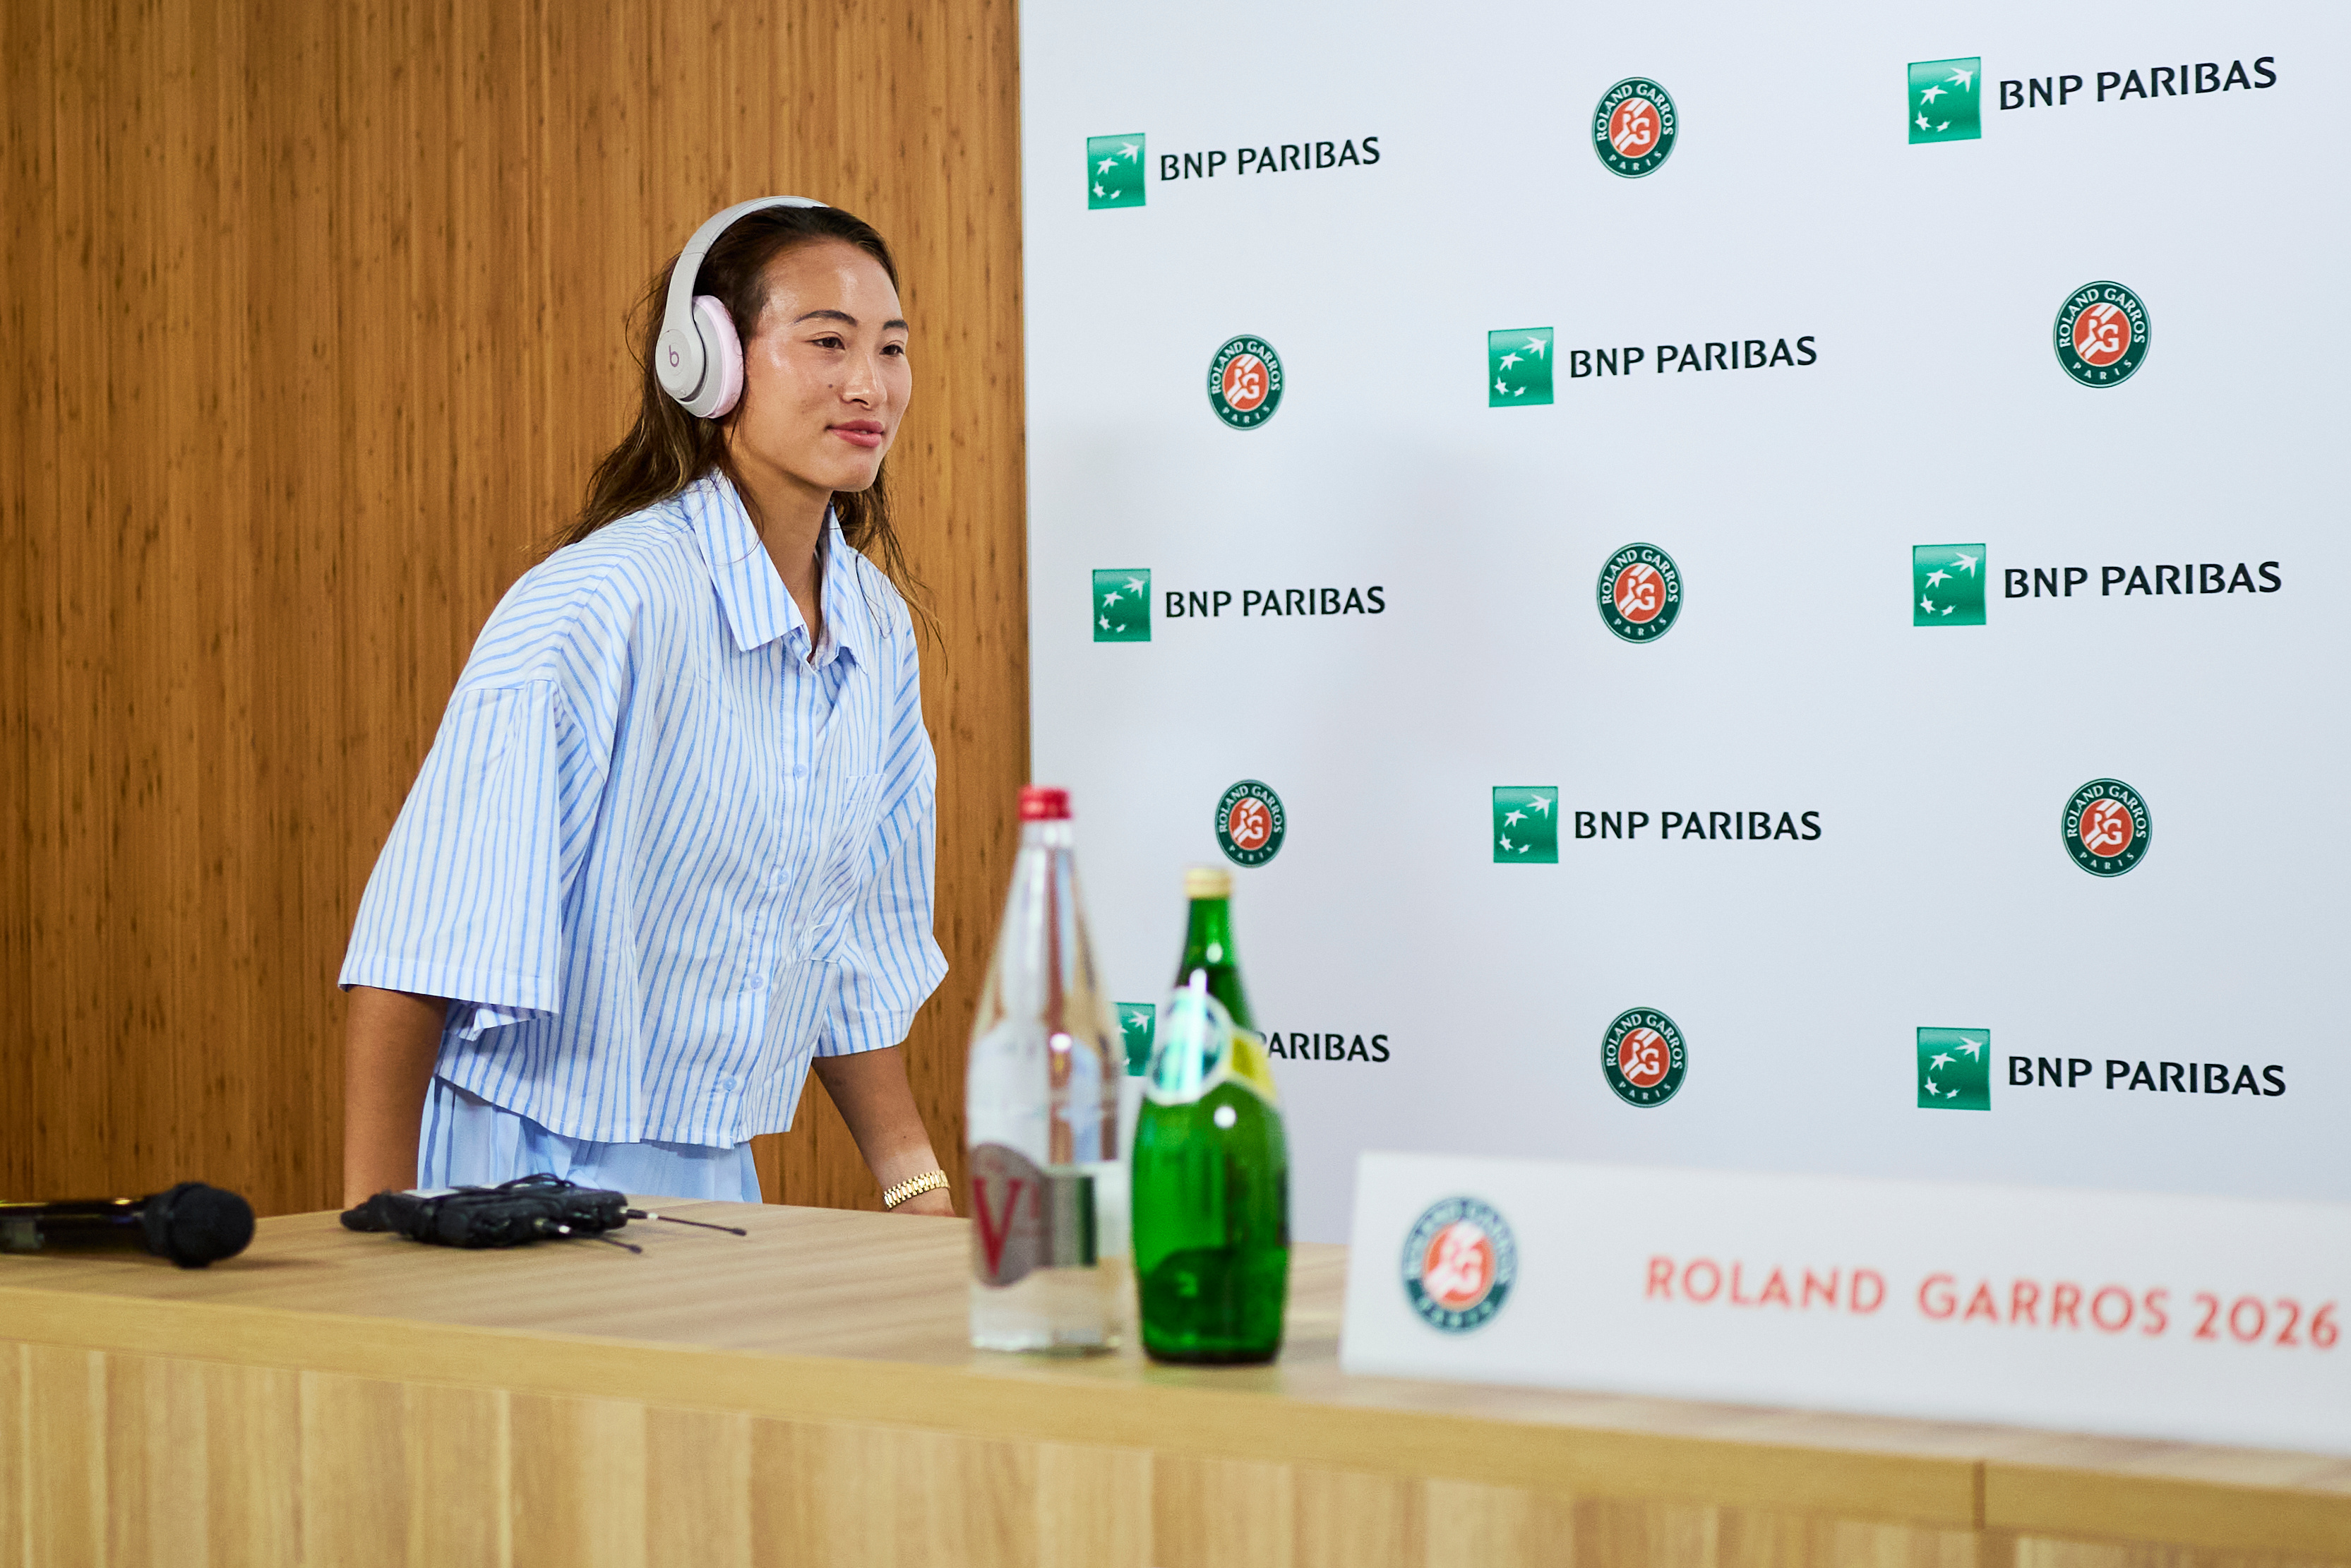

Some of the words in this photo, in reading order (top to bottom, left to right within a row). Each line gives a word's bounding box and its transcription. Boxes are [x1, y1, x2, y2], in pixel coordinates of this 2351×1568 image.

[2000, 75, 2083, 110] BNP
[2097, 56, 2278, 102] PARIBAS
[1596, 84, 1633, 142] ROLAND
[1636, 83, 1673, 136] GARROS
[1161, 150, 1227, 181] BNP
[1238, 136, 1381, 175] PARIBAS
[1608, 150, 1662, 171] PARIS
[2059, 288, 2100, 348] ROLAND
[2103, 287, 2146, 344] GARROS
[1211, 341, 1244, 395] ROLAND
[1246, 340, 1281, 391] GARROS
[1570, 347, 1645, 378] BNP
[1657, 335, 1818, 373] PARIBAS
[2072, 359, 2132, 380] PARIS
[1601, 549, 1638, 605] ROLAND
[1641, 549, 1679, 603] GARROS
[2004, 567, 2089, 599] BNP
[2102, 561, 2283, 597] PARIBAS
[1166, 590, 1233, 618] BNP
[1243, 585, 1386, 617] PARIBAS
[1613, 617, 1667, 636] PARIS
[1219, 785, 1249, 834] ROLAND
[1250, 785, 1283, 833] GARROS
[1575, 811, 1650, 839] BNP
[1661, 810, 1822, 841] PARIBAS
[2066, 784, 2104, 838] ROLAND
[2108, 785, 2147, 839] GARROS
[2079, 851, 2134, 870] PARIS
[1606, 1013, 1642, 1067] ROLAND
[1646, 1014, 1683, 1070] GARROS
[1618, 1081, 1671, 1101] PARIS
[2009, 1055, 2093, 1088] BNP
[2105, 1059, 2287, 1097] PARIBAS
[1646, 1255, 1886, 1315] ROLAND
[1916, 1272, 2171, 1336] GARROS
[2191, 1291, 2340, 1351] 2026
